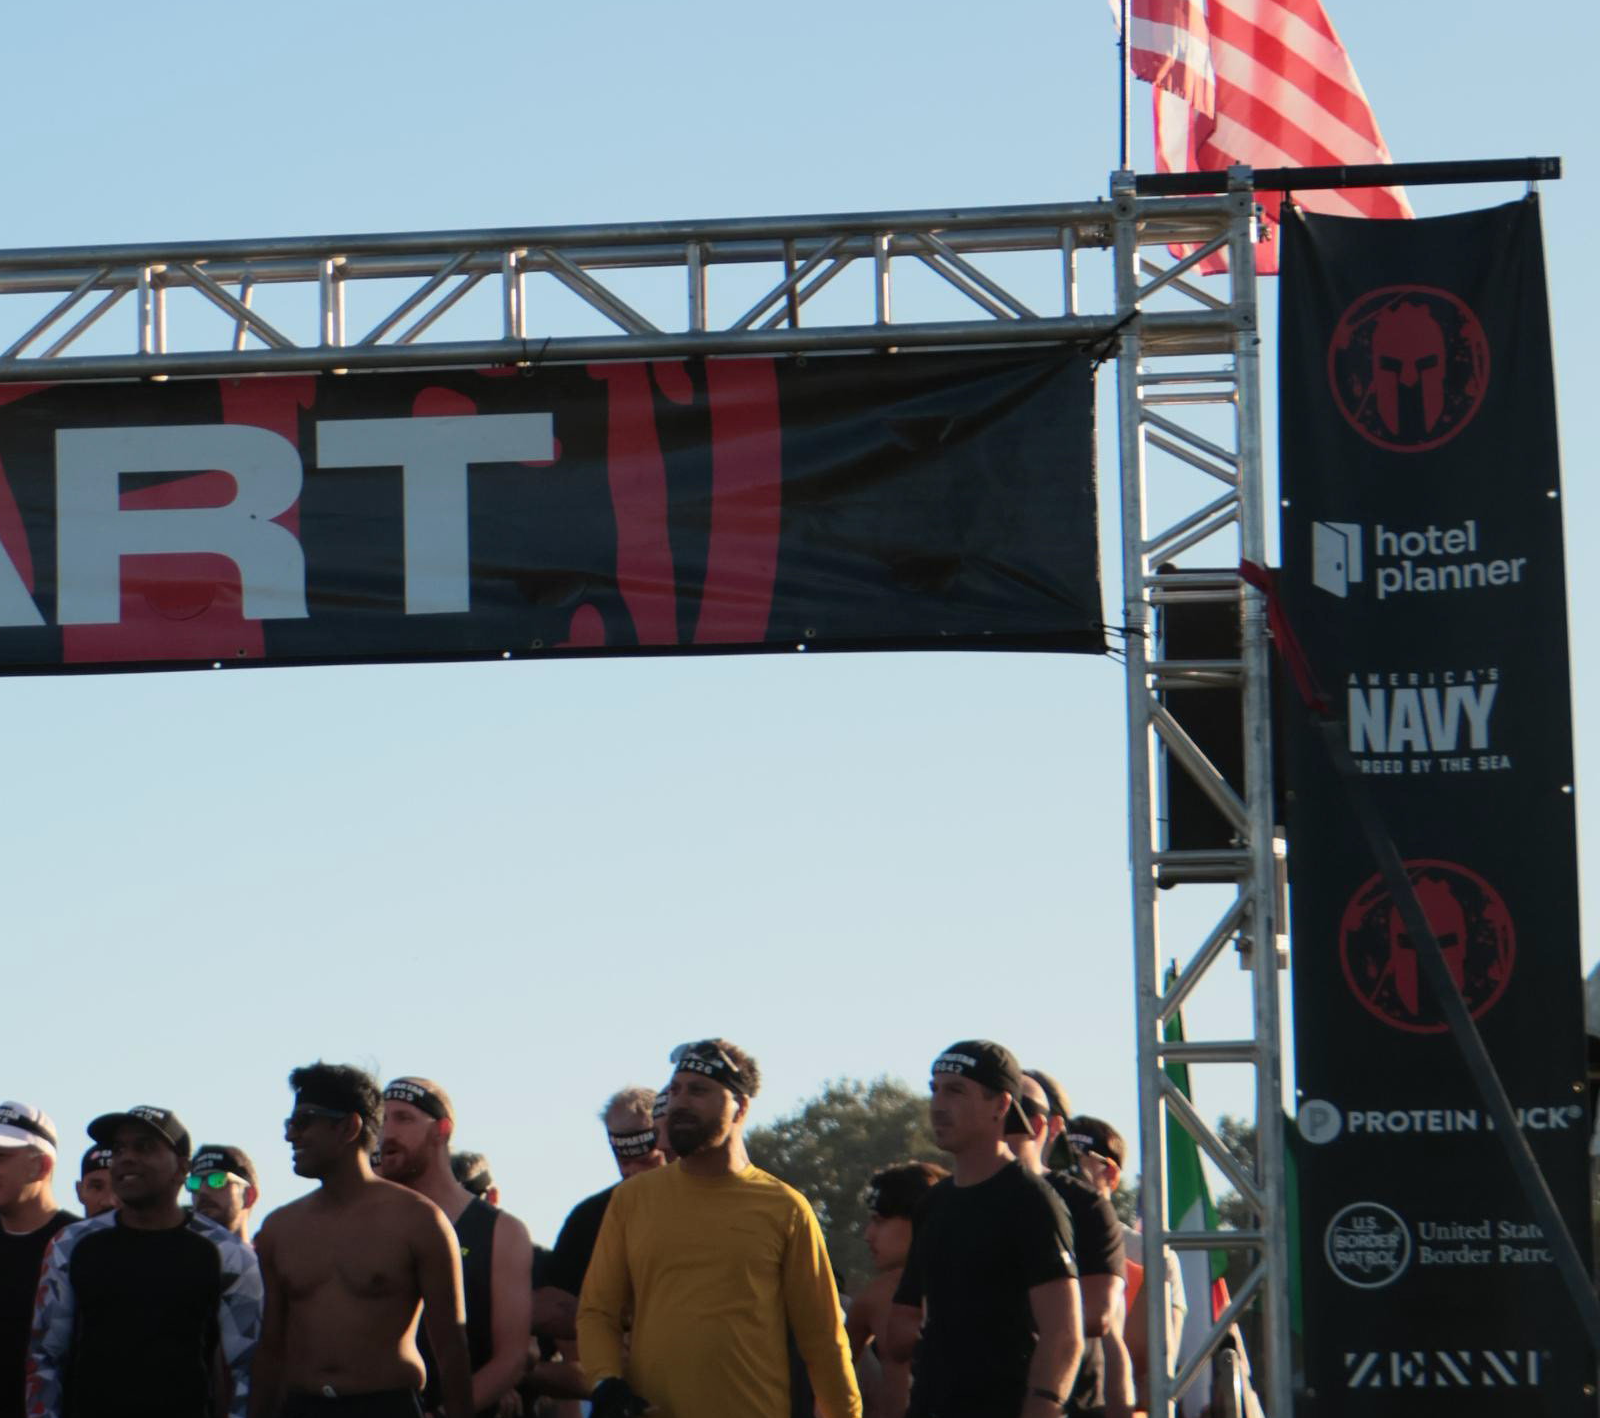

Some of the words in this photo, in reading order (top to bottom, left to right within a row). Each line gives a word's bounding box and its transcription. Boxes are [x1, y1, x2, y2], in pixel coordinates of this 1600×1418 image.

[1374, 520, 1477, 557] hotel
[1375, 557, 1527, 600] planner
[1347, 668, 1500, 686] AMERICA'S
[1347, 684, 1498, 753] NAVY
[1355, 759, 1403, 774] RGED
[1410, 759, 1432, 774] BY
[1438, 757, 1472, 772] THE
[1478, 755, 1512, 771] SEA
[1347, 1109, 1478, 1133] PROTEIN
[1418, 1220, 1492, 1240] United
[1497, 1220, 1545, 1239] Stat
[1336, 1234, 1399, 1248] BORDER
[1336, 1251, 1399, 1265] PATROL
[1418, 1244, 1492, 1264] Border
[1498, 1244, 1555, 1263] Patro
[1343, 1350, 1539, 1389] ZENNI
